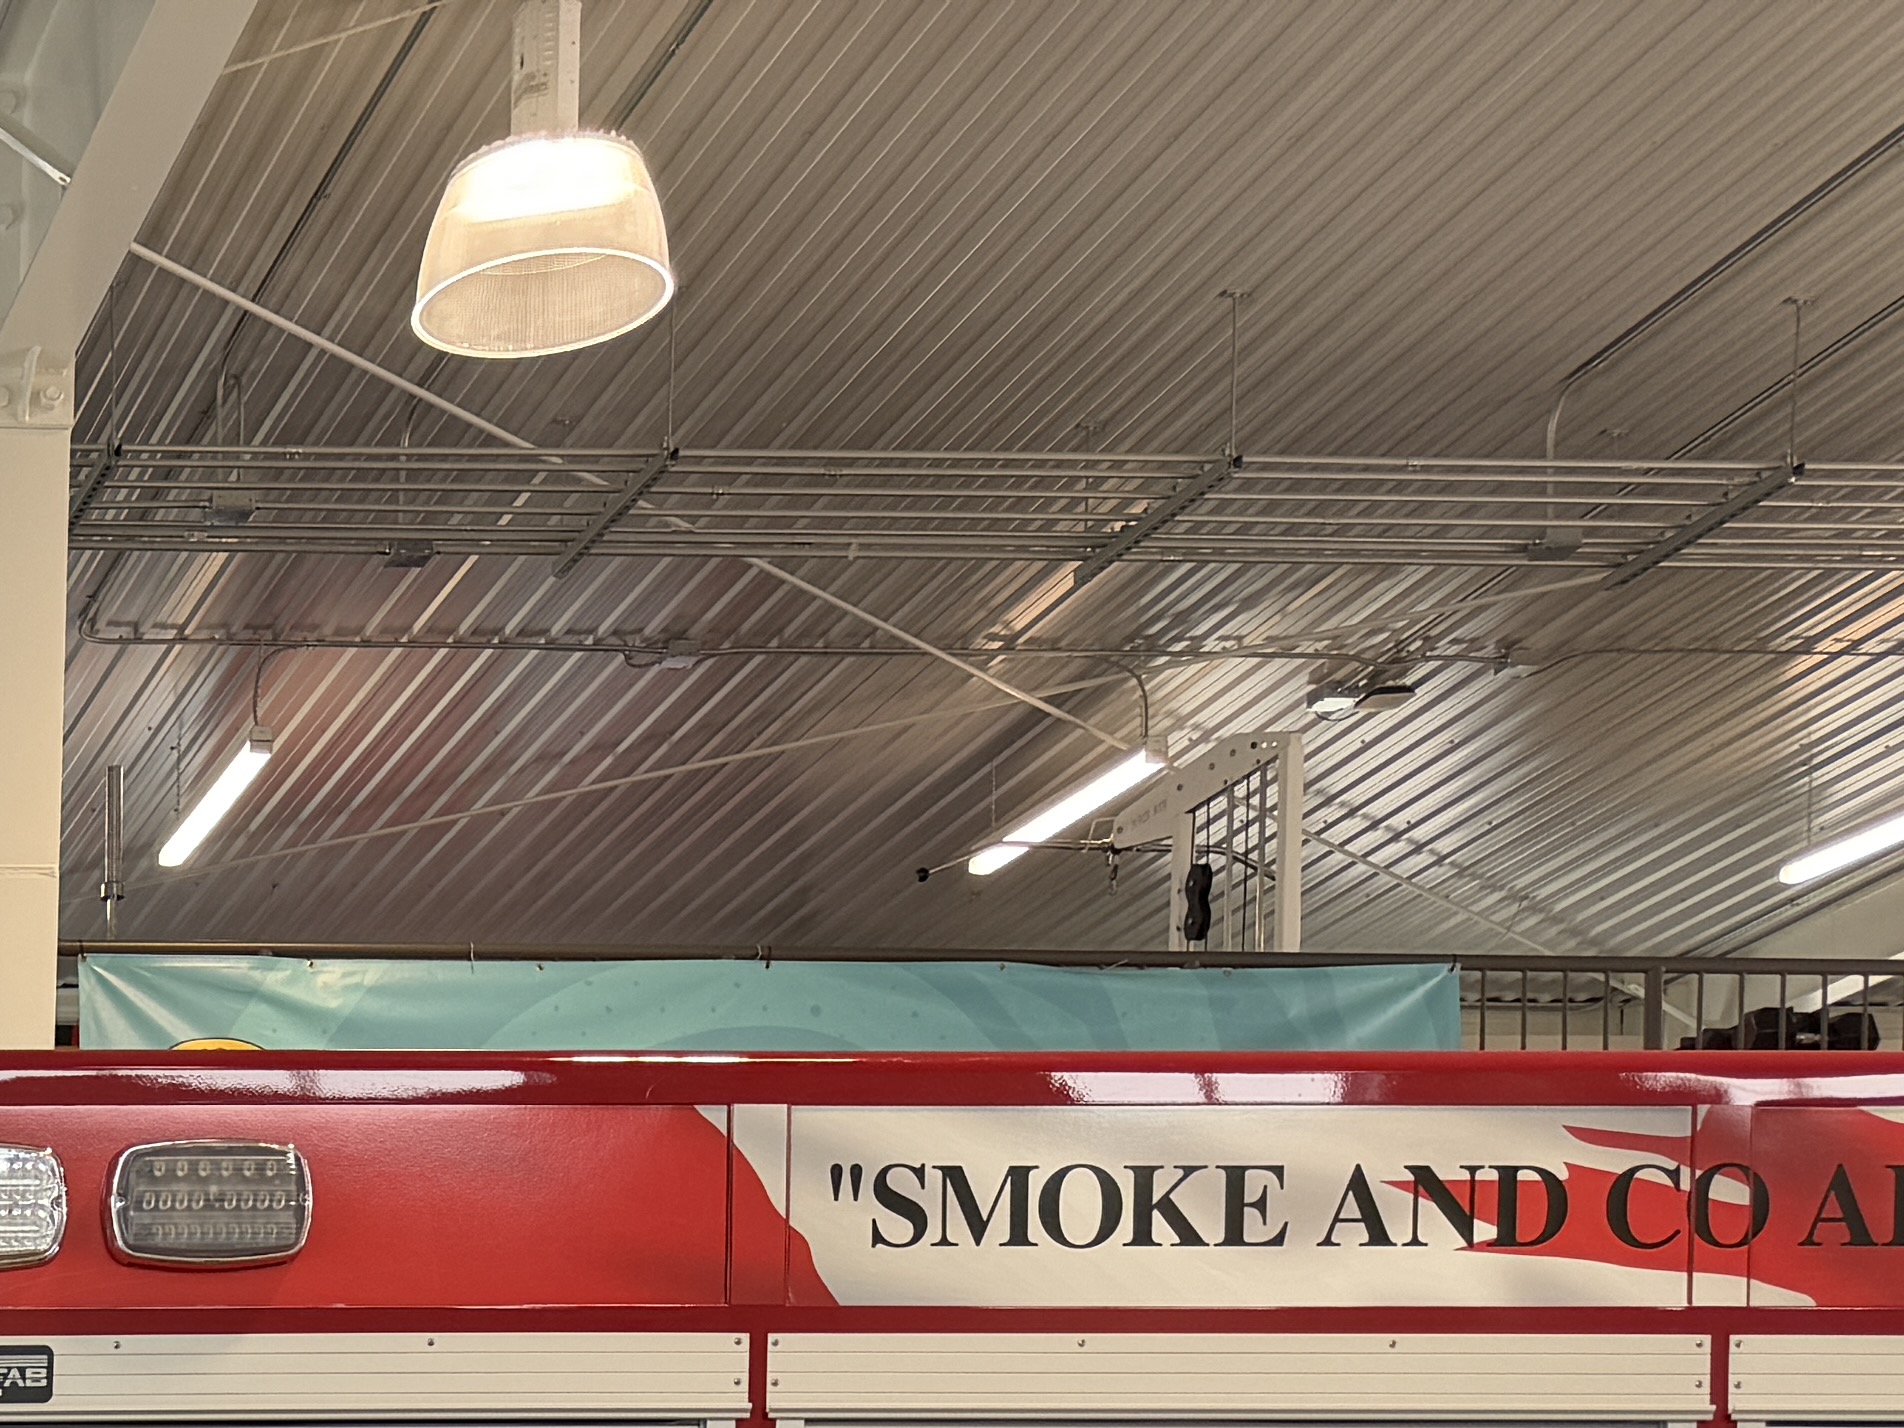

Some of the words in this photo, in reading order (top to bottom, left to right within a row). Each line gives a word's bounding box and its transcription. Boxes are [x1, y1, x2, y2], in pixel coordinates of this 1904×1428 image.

[829, 1163, 1290, 1249] "SMOKE
[1318, 1163, 1569, 1249] AND
[1606, 1162, 1769, 1250] CO
